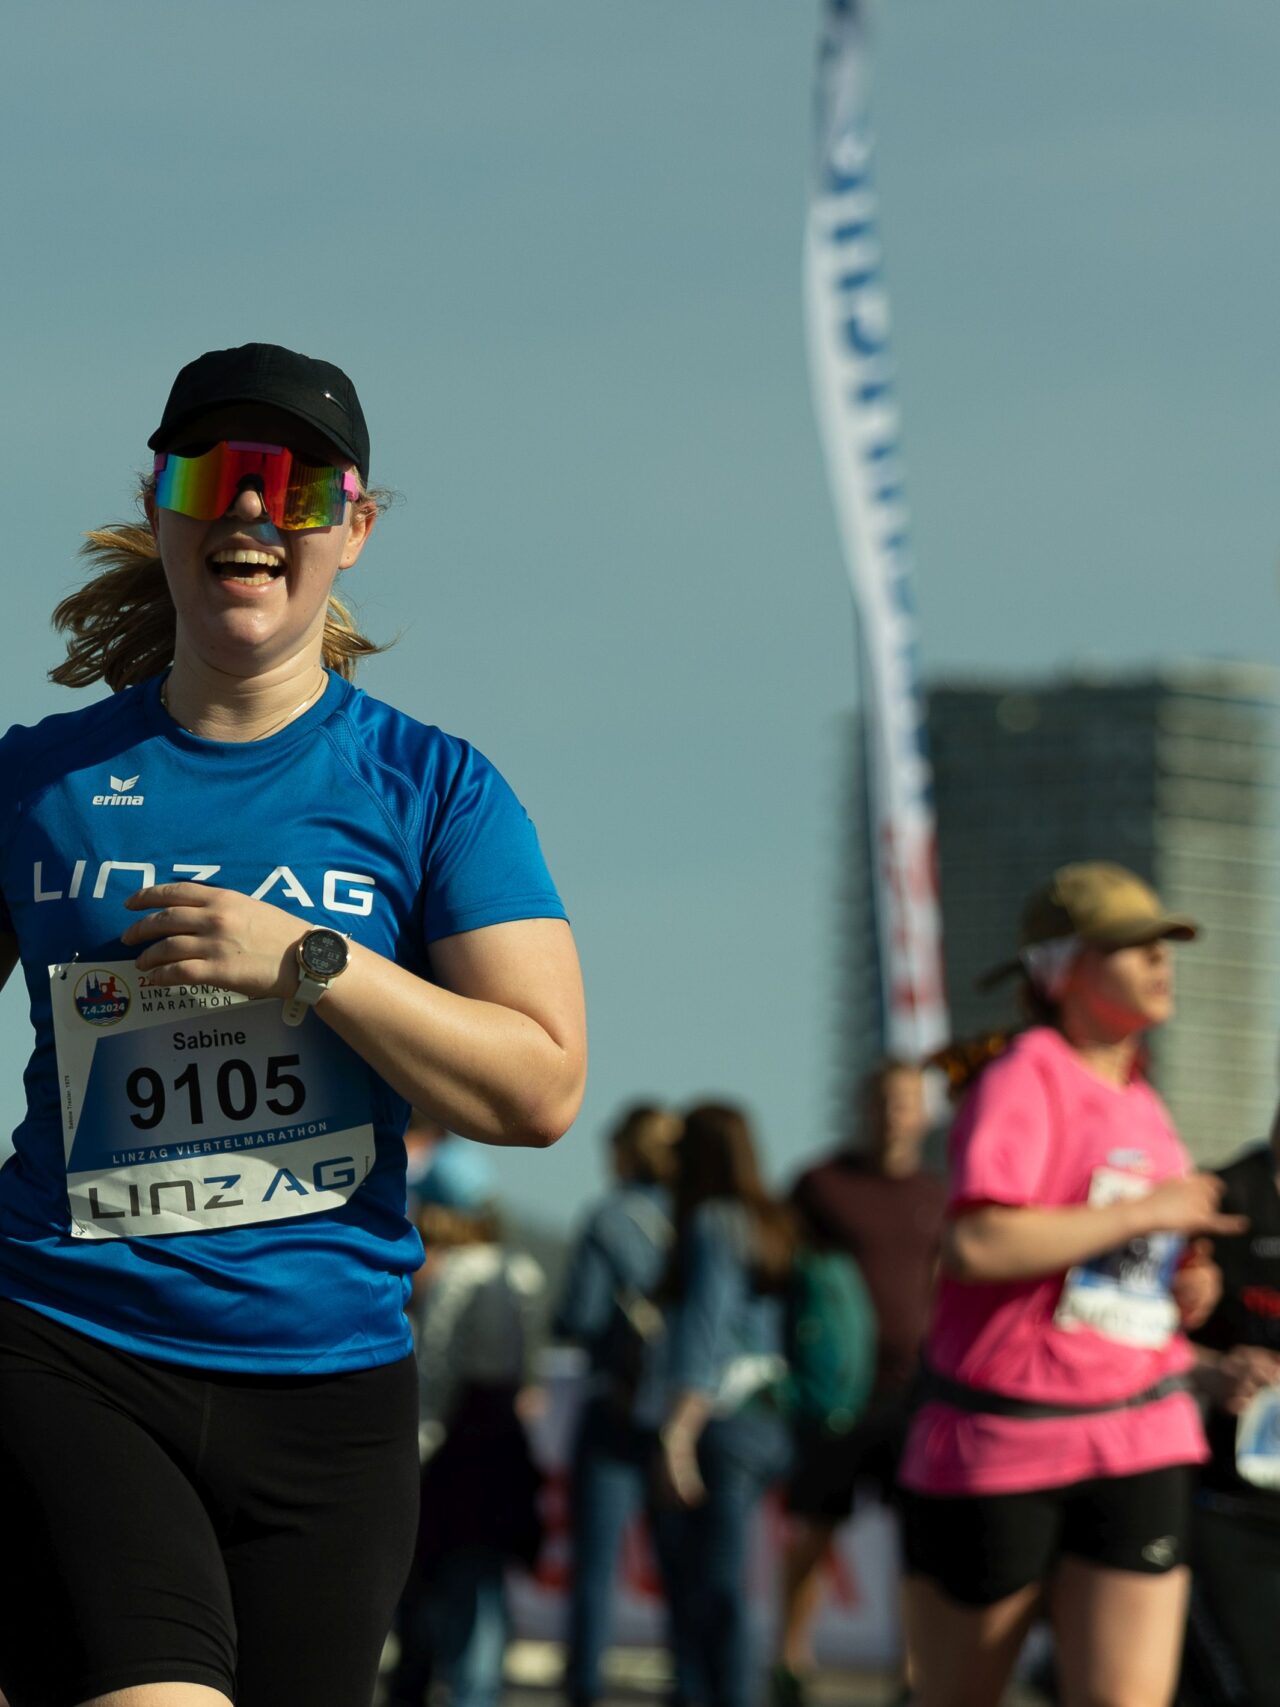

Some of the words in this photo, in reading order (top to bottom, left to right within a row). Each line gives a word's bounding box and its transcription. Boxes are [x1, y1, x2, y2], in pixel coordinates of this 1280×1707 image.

[92, 793, 145, 807] erima
[249, 865, 376, 916] AG
[140, 987, 171, 1001] LINZ
[142, 995, 233, 1013] MARATHON
[81, 1002, 126, 1016] 7.4.2024
[173, 1030, 247, 1051] Sabine
[126, 1054, 307, 1130] 9105
[176, 1122, 328, 1156] VIERTELMARATHON
[88, 1174, 244, 1220] LINZ
[262, 1156, 357, 1203] AG
